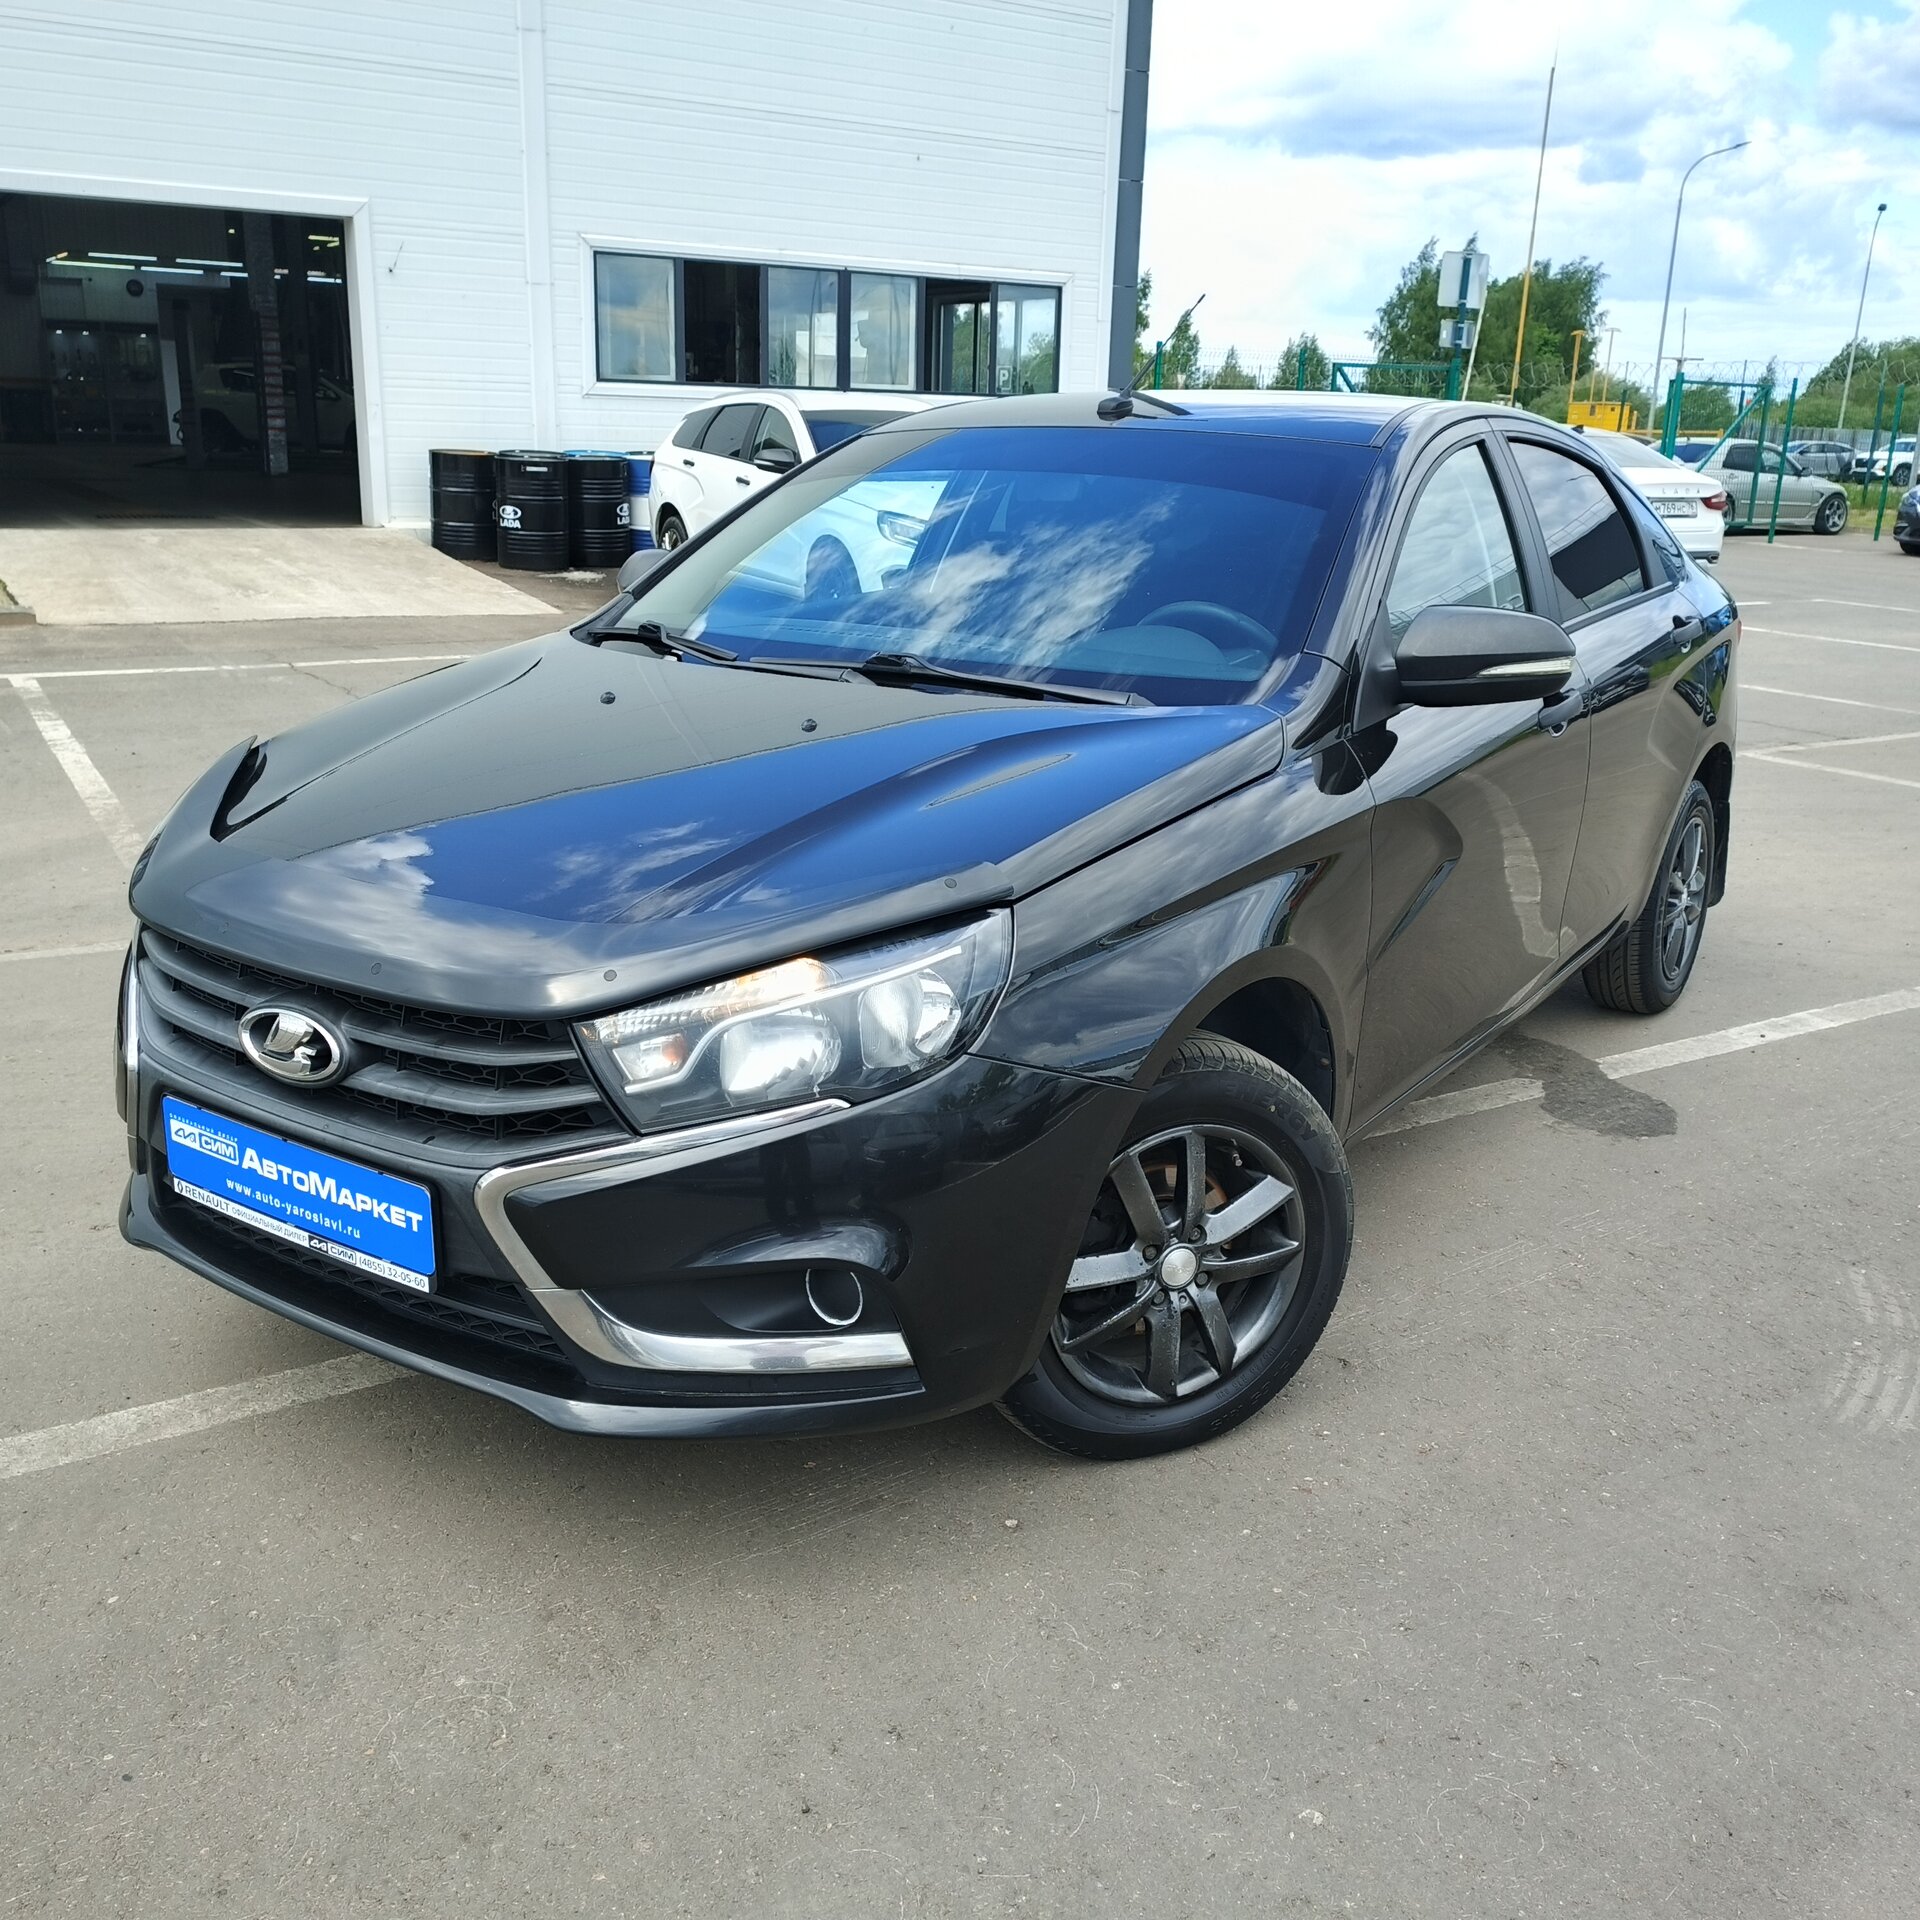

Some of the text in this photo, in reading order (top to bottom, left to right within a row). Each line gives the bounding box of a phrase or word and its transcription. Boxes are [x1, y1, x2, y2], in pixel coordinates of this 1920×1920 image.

[500, 518, 522, 529] LADA
[201, 1136, 235, 1160] СИМ
[184, 1185, 230, 1213] RENAULT
[231, 1206, 283, 1235] ОФИЦИАЛЬНЫЙ
[329, 1246, 355, 1263] СИМ
[358, 1255, 426, 1289] (4855) 32-05-60
